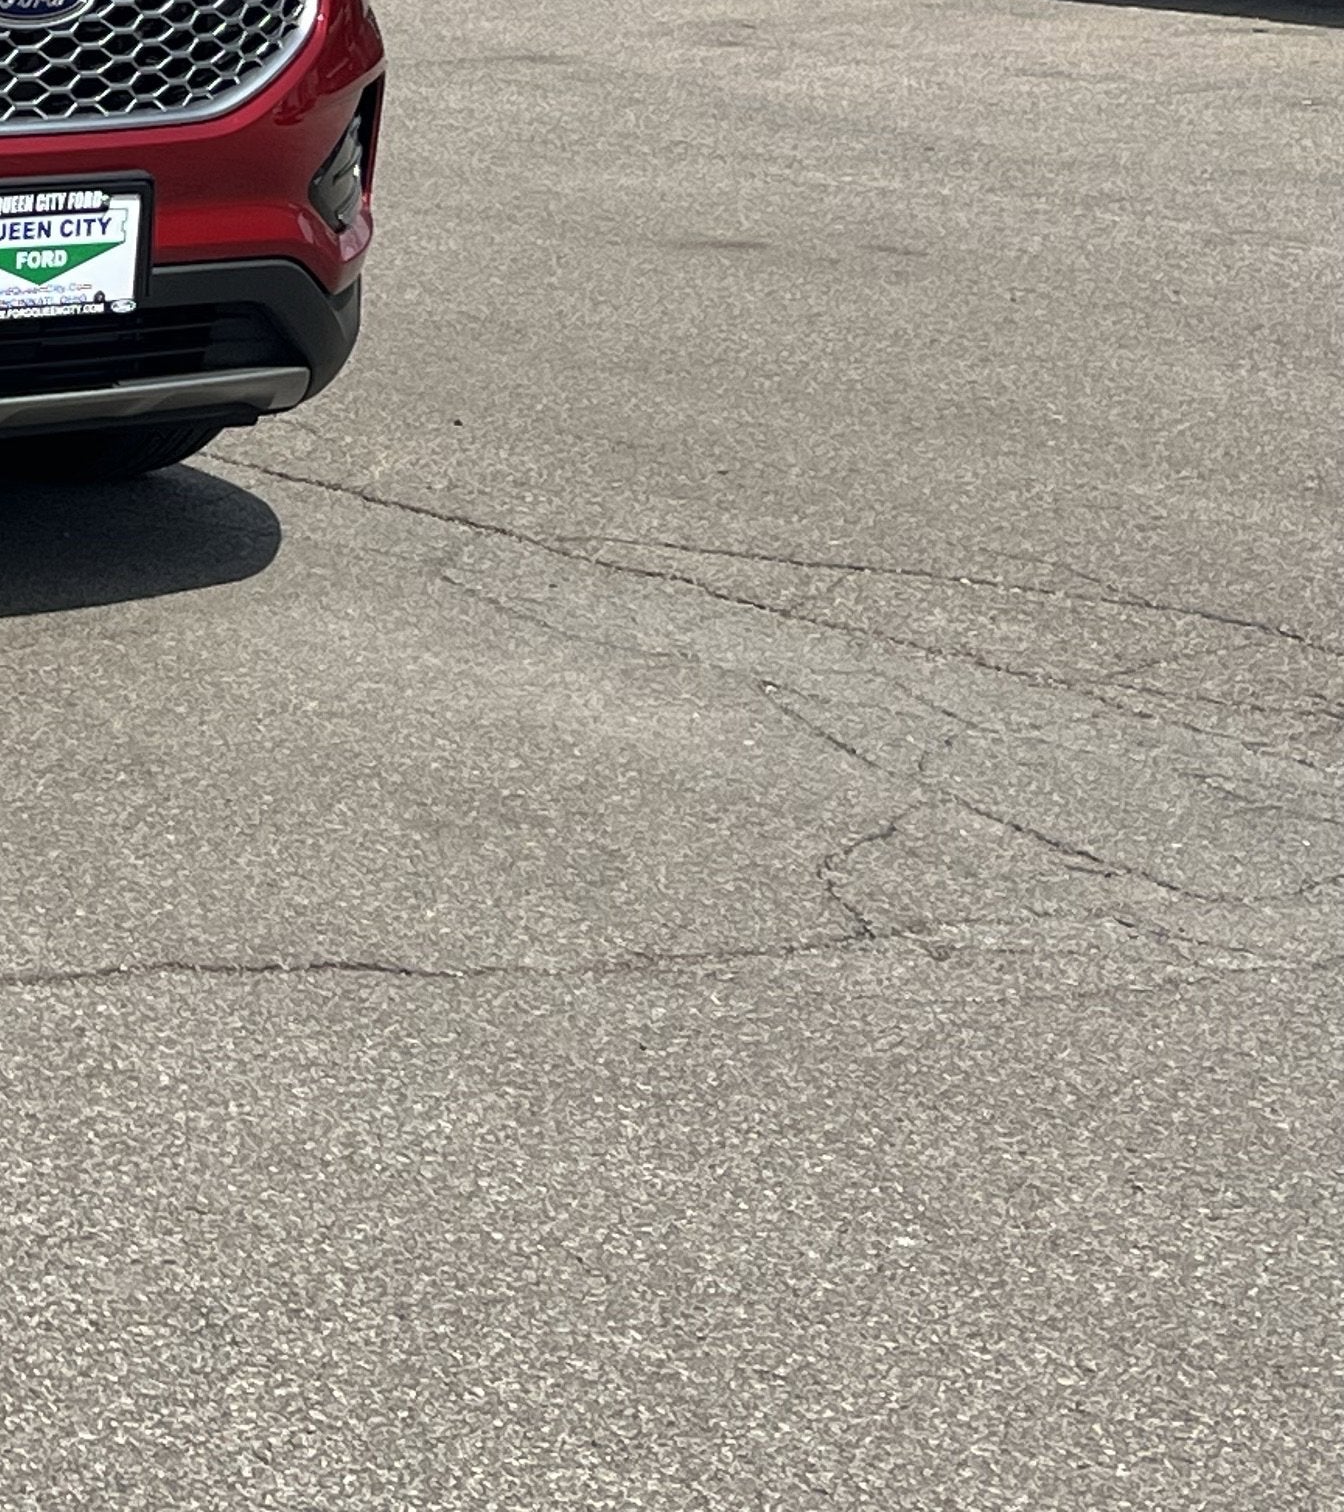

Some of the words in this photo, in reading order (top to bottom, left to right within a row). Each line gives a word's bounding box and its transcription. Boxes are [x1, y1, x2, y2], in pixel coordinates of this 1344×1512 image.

[35, 192, 67, 211] CITY
[68, 190, 102, 209] FORD
[60, 217, 112, 237] CITY
[15, 250, 68, 269] FORD
